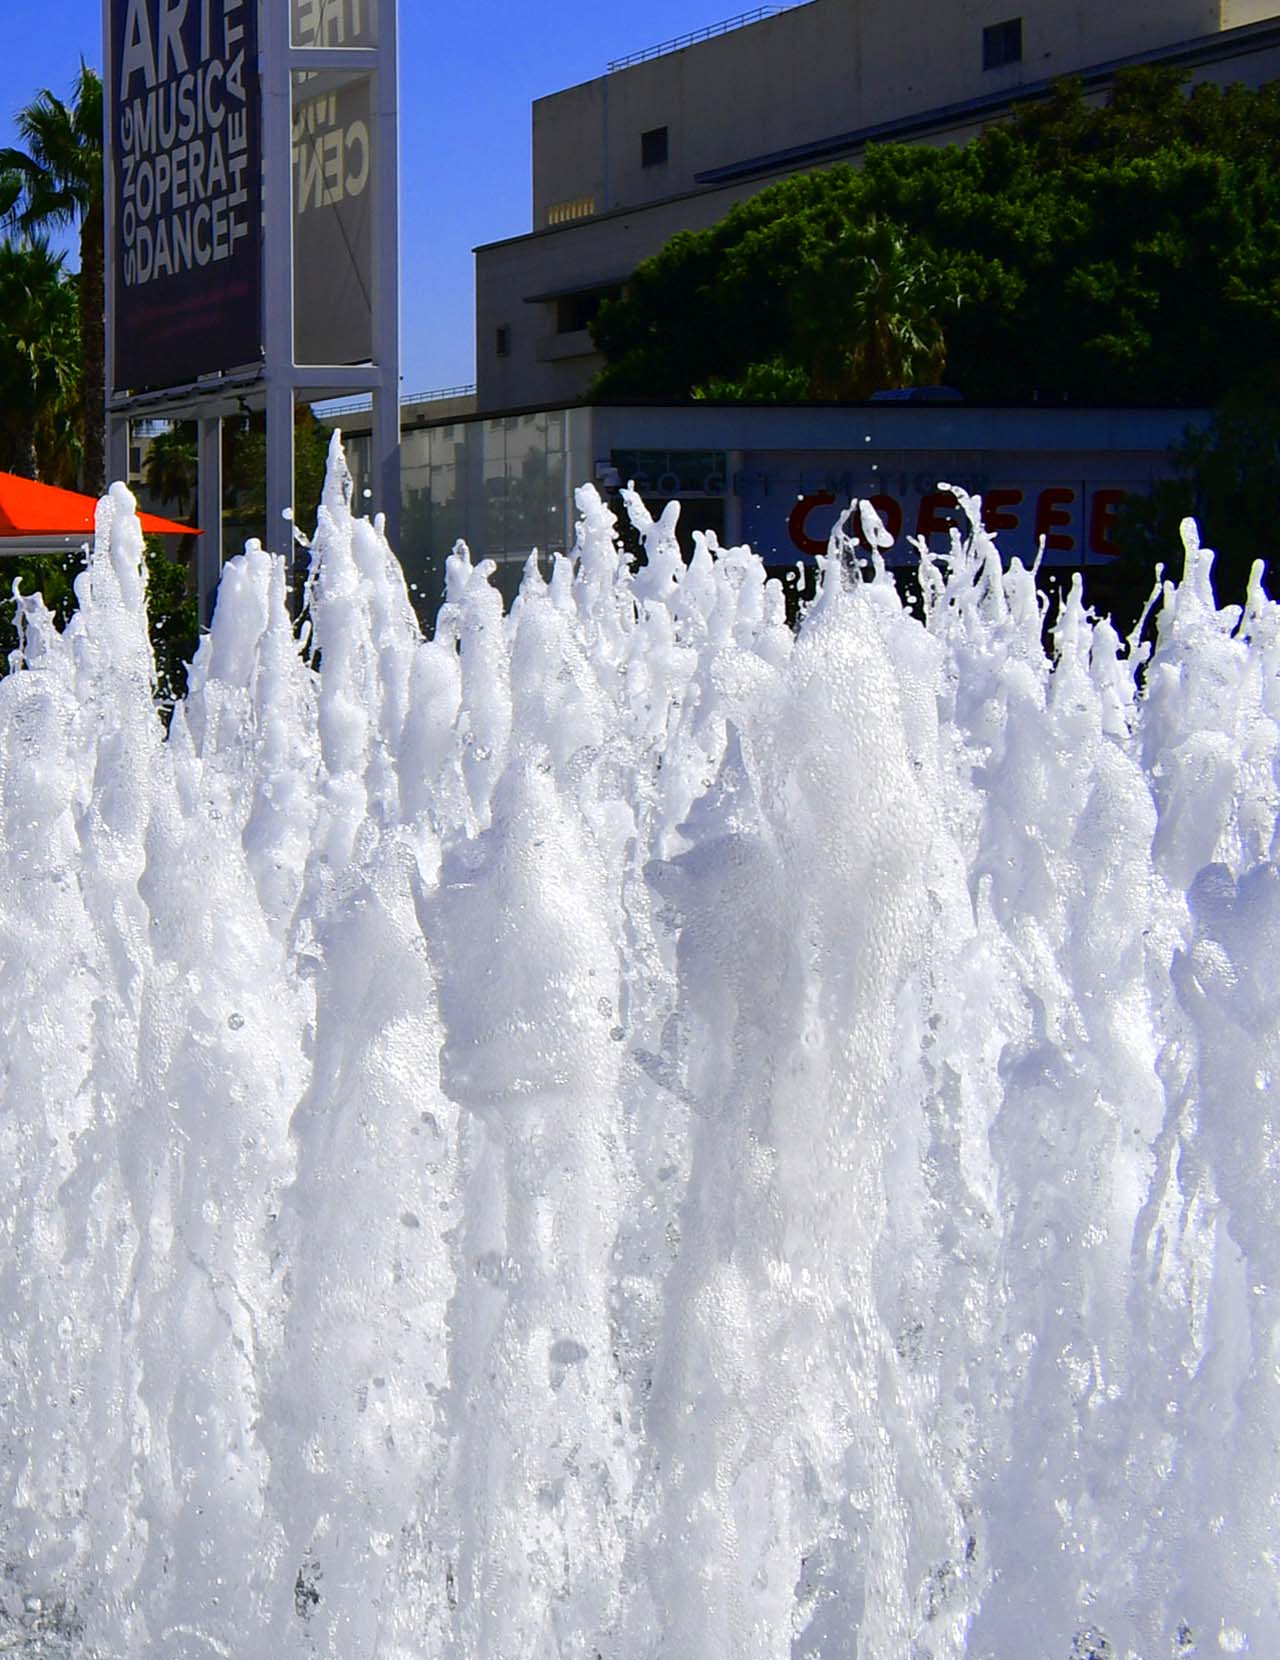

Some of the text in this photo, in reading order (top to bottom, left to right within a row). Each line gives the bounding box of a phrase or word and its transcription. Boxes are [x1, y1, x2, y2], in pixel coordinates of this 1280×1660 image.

[133, 59, 225, 162] MUSIC
[223, 0, 249, 256] THEAT
[120, 106, 137, 288] SONG
[136, 131, 228, 221] OPERA
[136, 196, 229, 285] DANCE
[787, 488, 1130, 557] COFFEE
